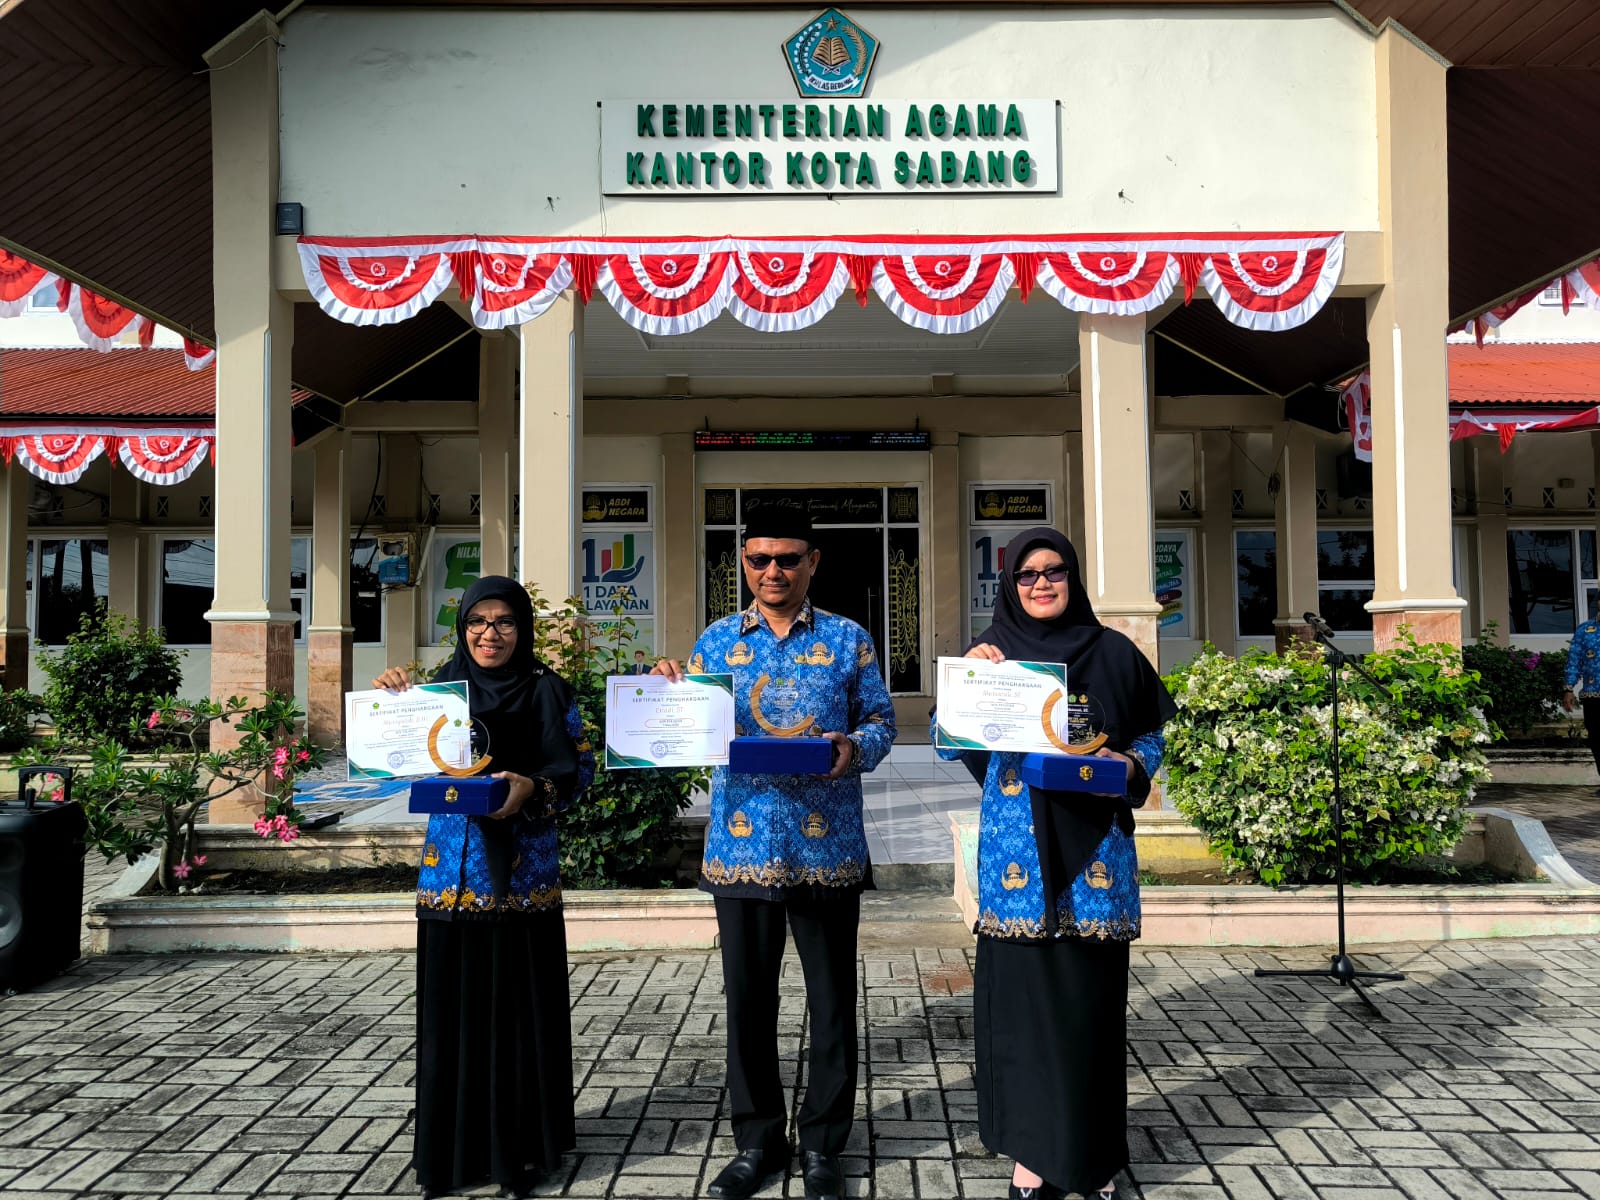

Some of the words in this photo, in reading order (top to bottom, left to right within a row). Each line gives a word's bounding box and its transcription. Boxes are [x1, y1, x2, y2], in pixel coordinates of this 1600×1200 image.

[637, 103, 884, 137] KEMENTERIAN
[904, 103, 1022, 137] AGAMA
[626, 151, 766, 185] KANTOR
[786, 151, 874, 185] KOTA
[894, 150, 1031, 183] SABANG
[608, 497, 631, 507] ABDI
[1007, 495, 1030, 505] ABDI
[608, 507, 645, 517] NEGARA
[1007, 504, 1043, 514] NEGARA
[583, 585, 590, 598] 1
[586, 599, 649, 611] LAYANAN
